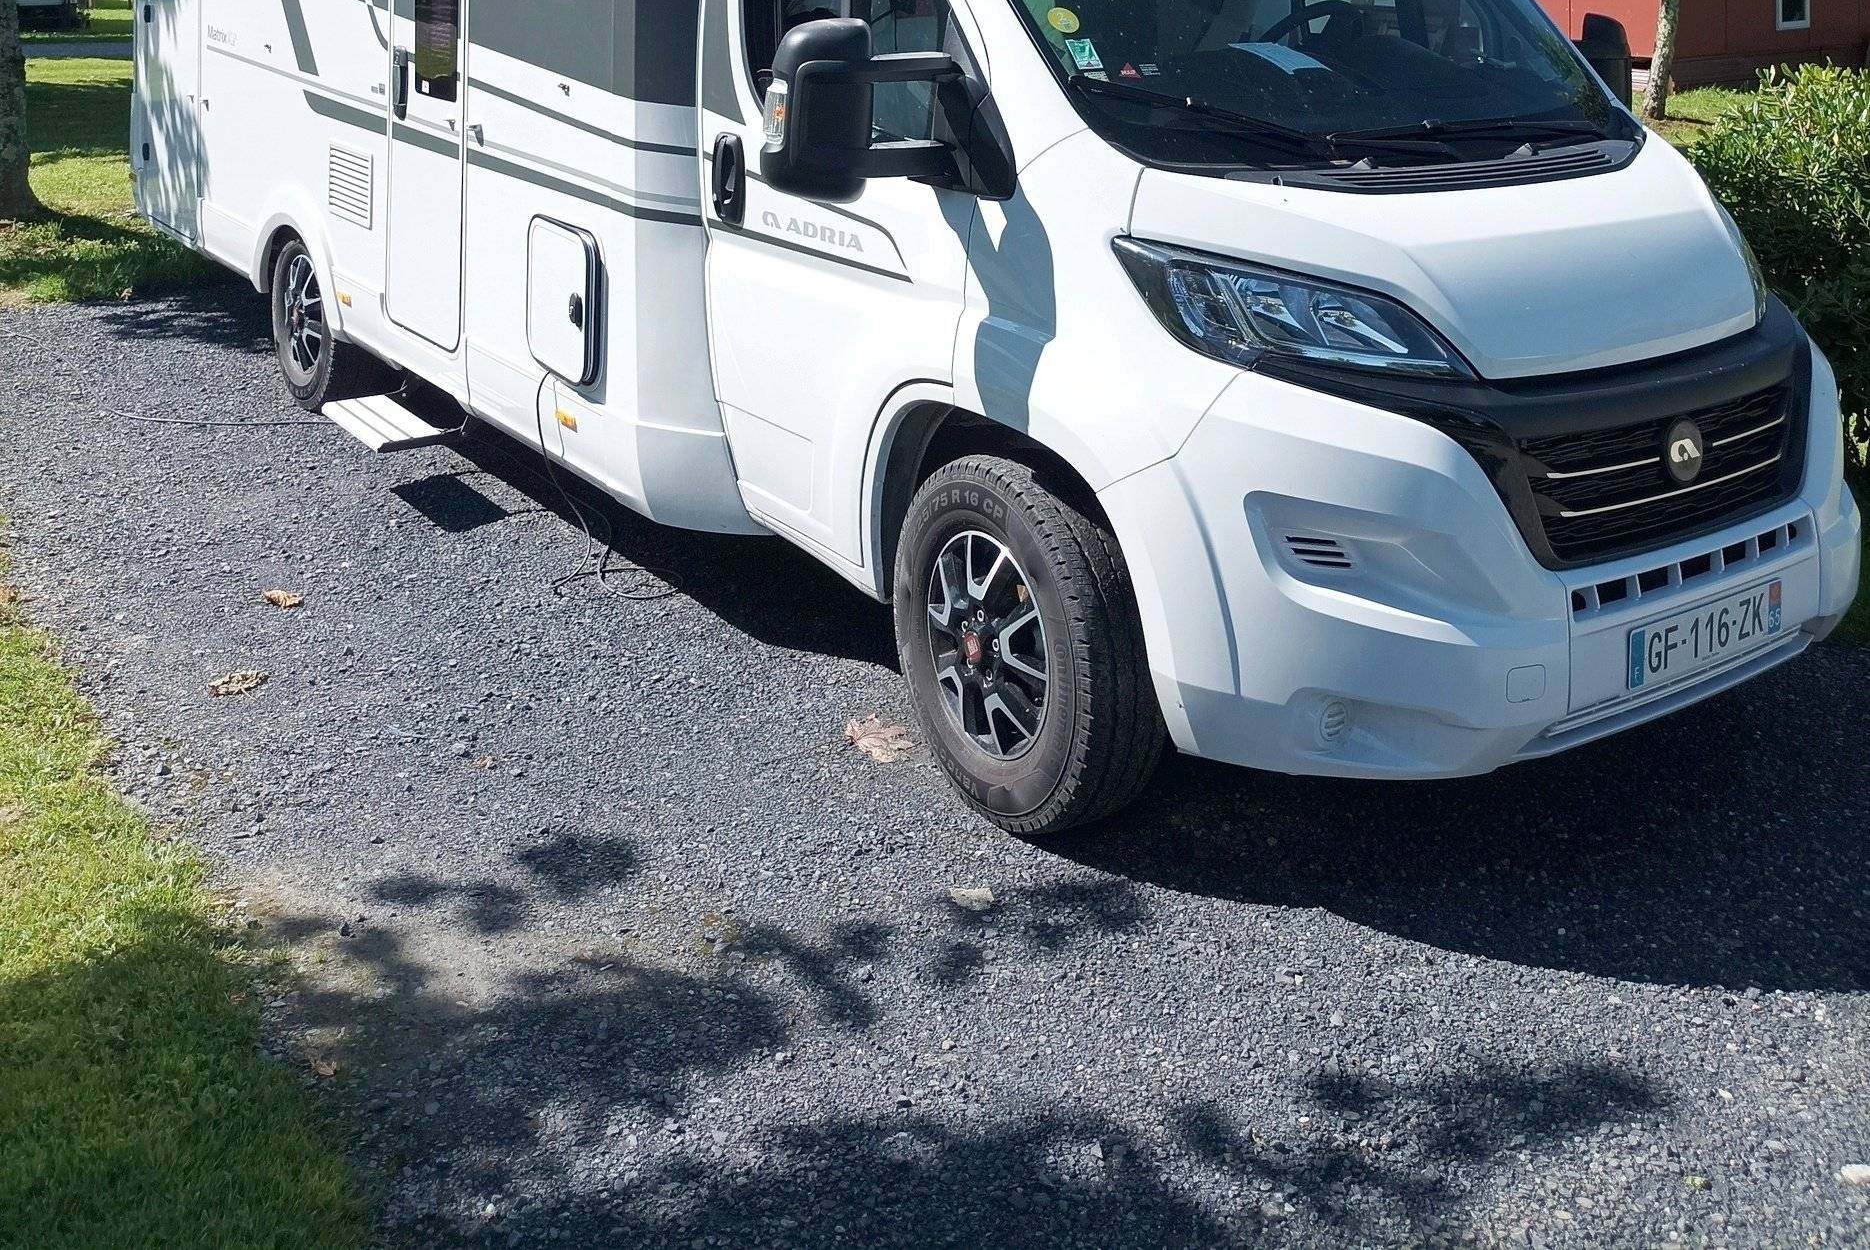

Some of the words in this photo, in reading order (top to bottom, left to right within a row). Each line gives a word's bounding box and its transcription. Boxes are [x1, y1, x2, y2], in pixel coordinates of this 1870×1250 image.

[786, 217, 865, 253] ADRIA
[951, 489, 961, 504] R
[964, 490, 979, 507] 16
[1647, 592, 1766, 674] GF-116-ZK
[1768, 607, 1781, 628] 65
